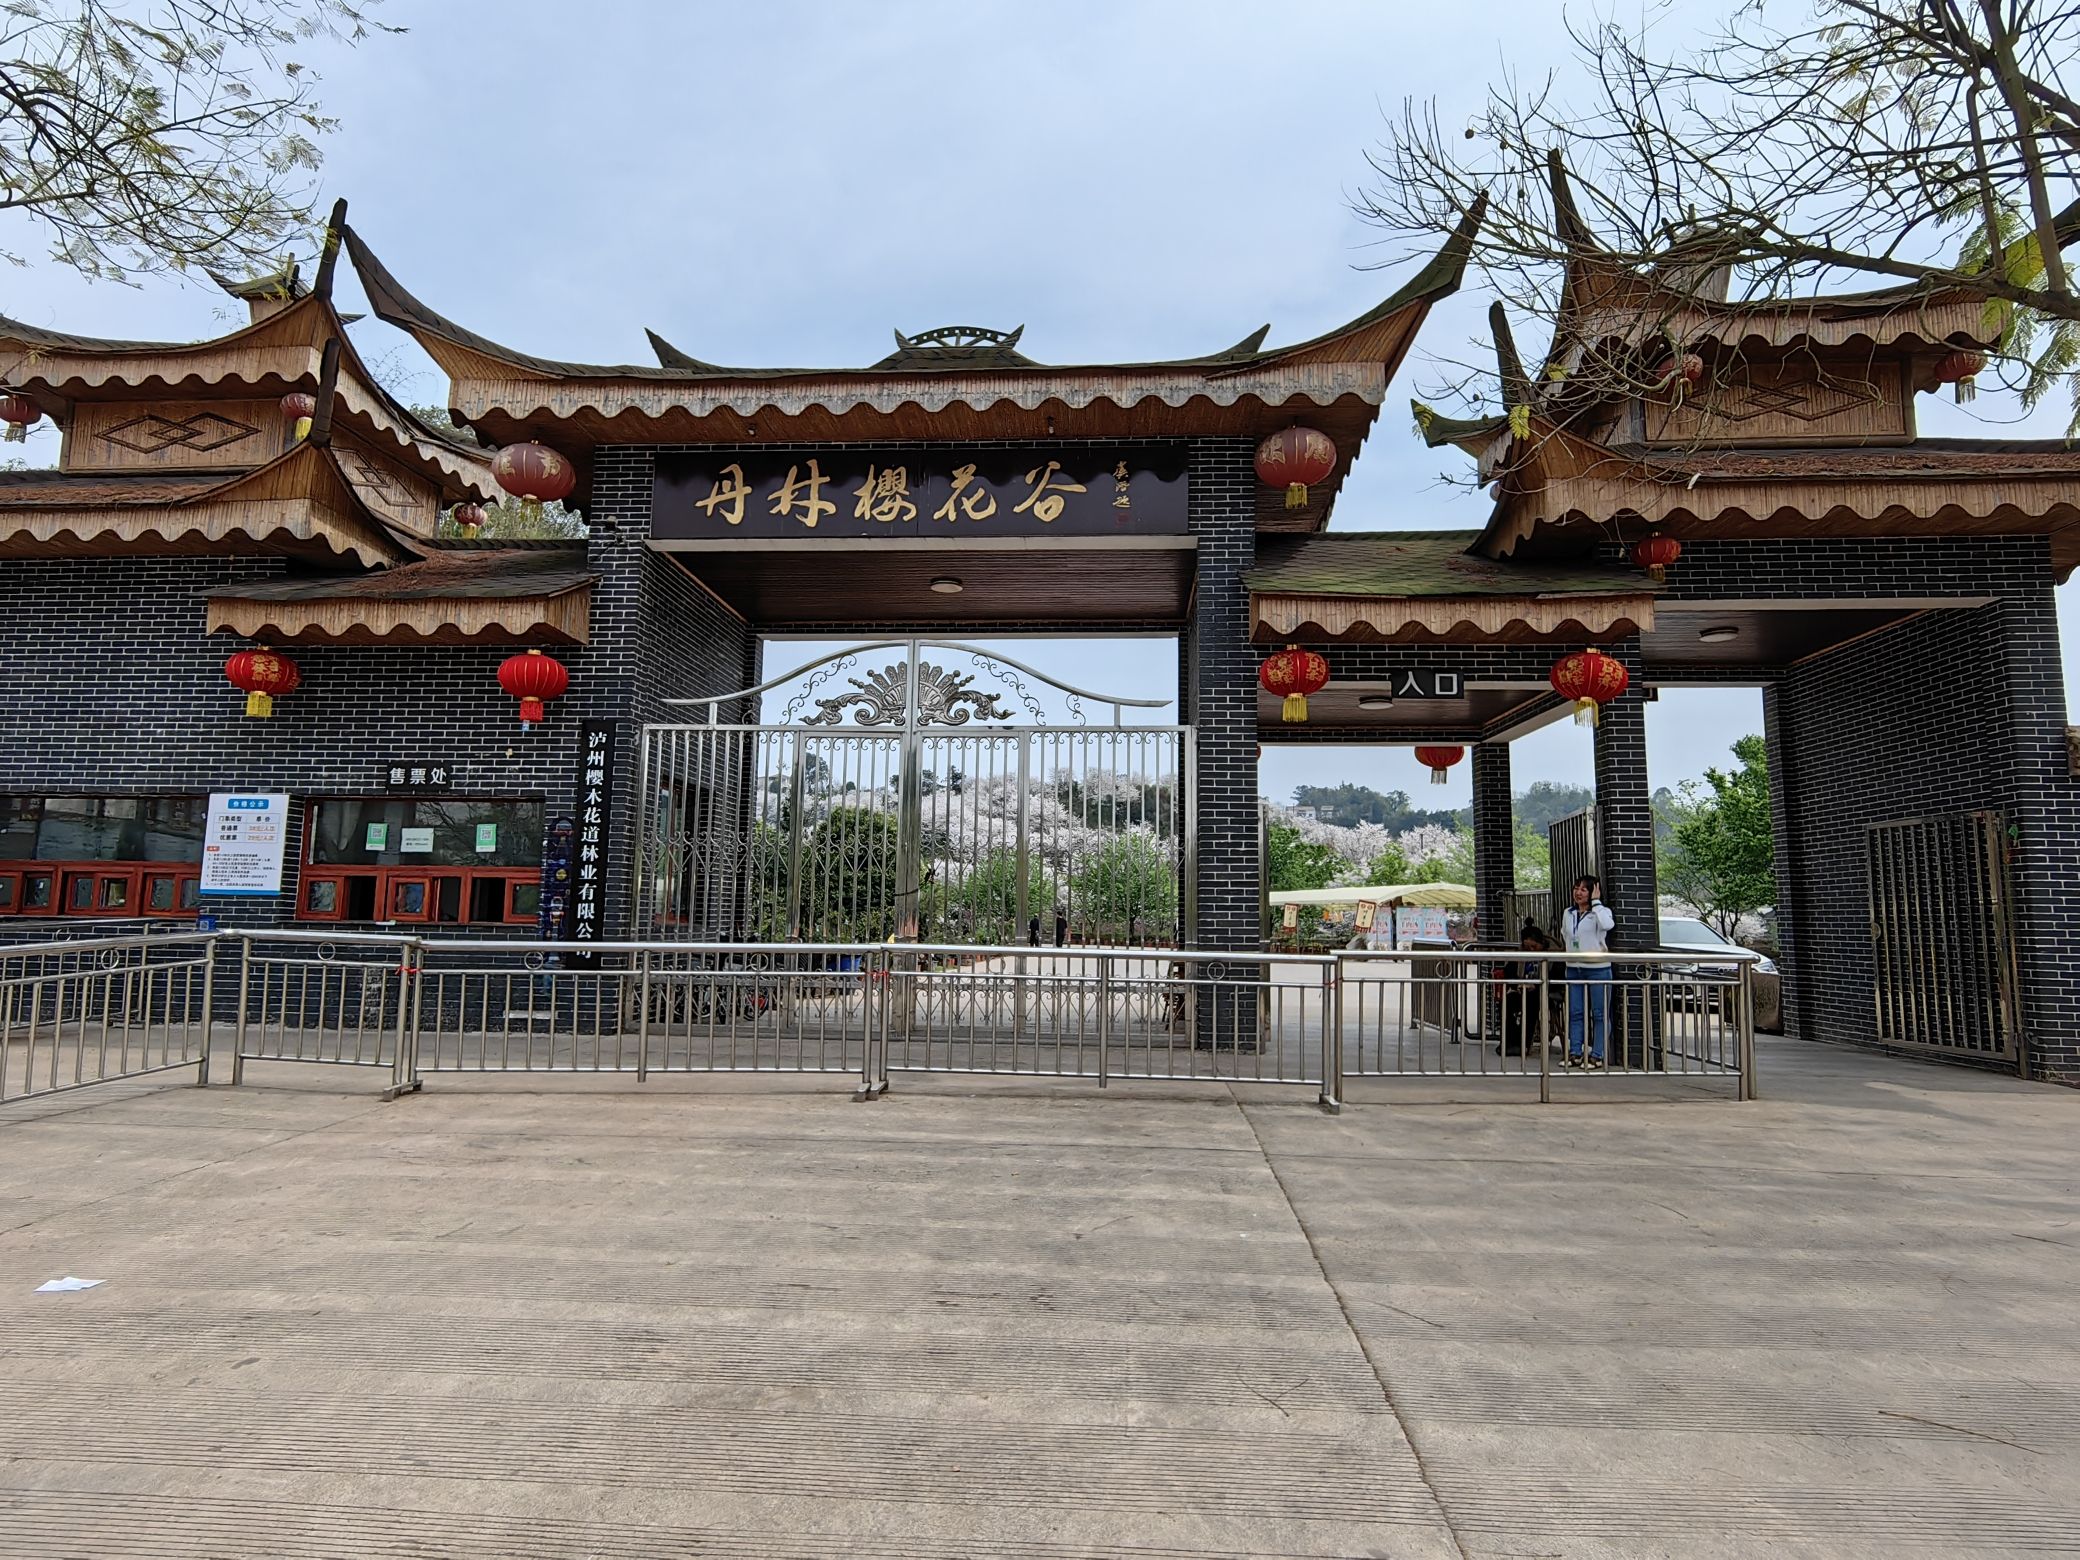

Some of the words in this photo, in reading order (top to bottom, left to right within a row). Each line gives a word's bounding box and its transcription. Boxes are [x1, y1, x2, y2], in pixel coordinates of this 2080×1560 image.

[1398, 671, 1459, 696] 入口
[389, 767, 447, 785] 售票处
